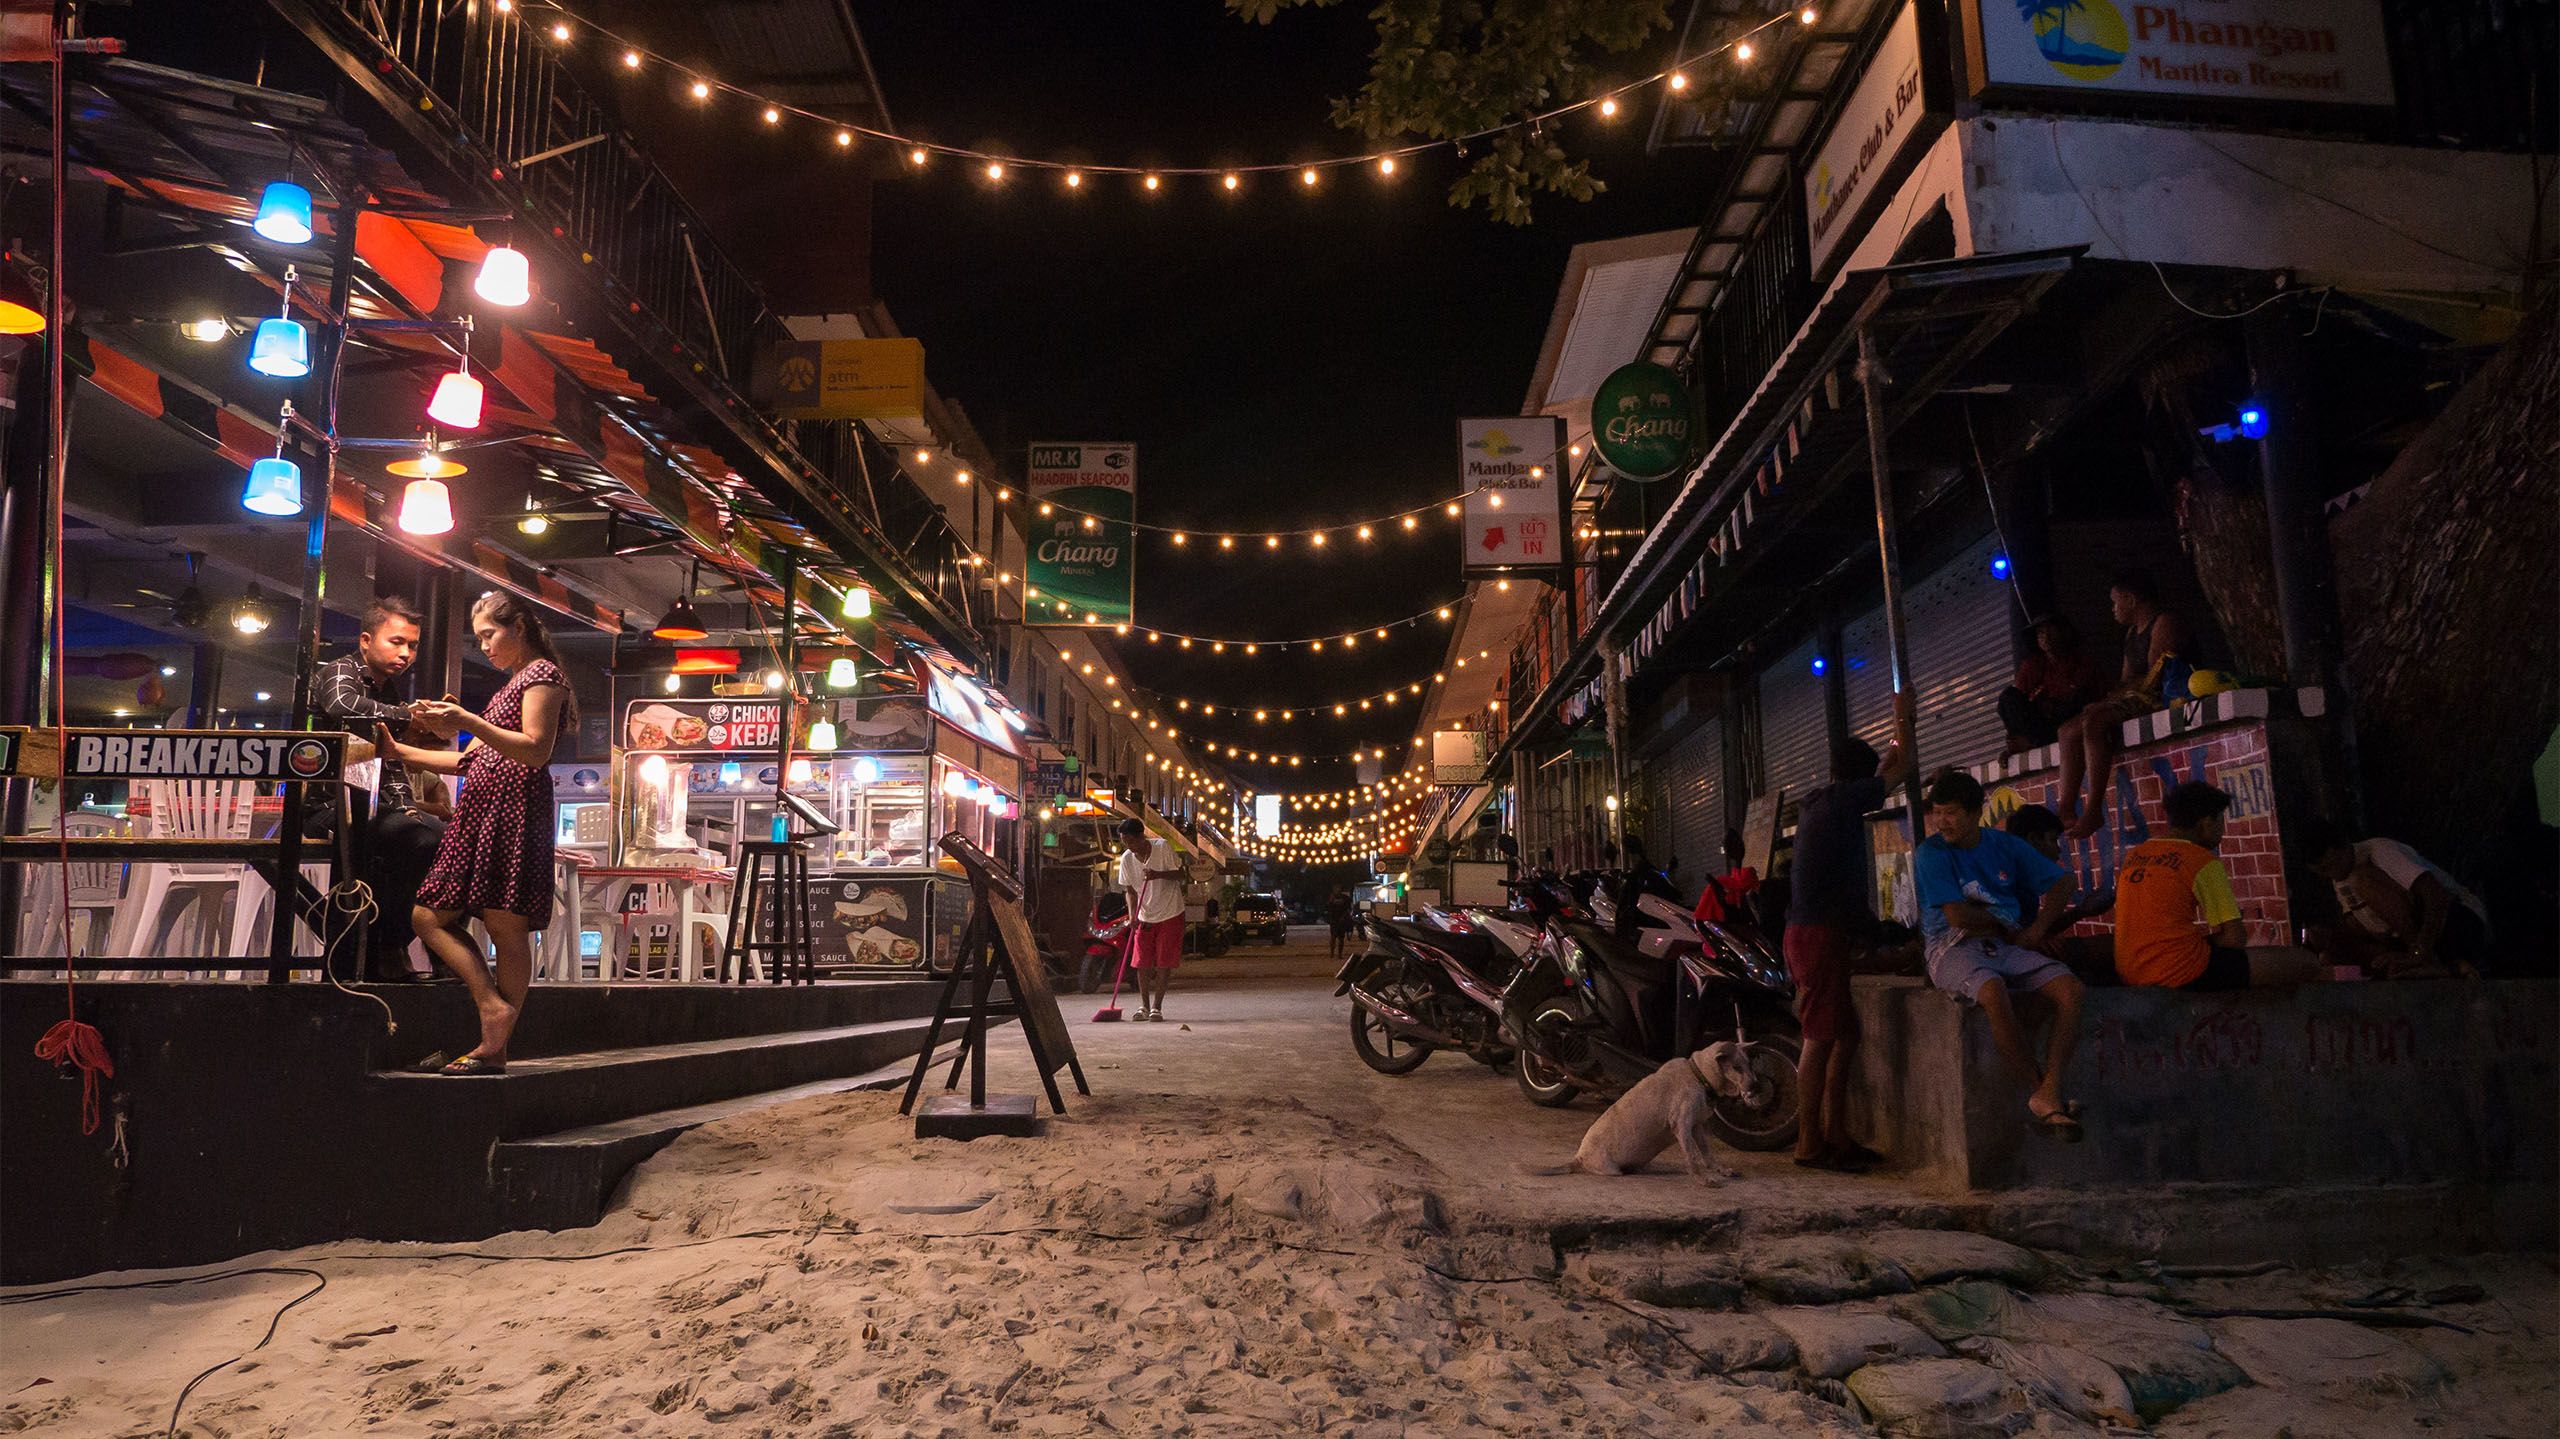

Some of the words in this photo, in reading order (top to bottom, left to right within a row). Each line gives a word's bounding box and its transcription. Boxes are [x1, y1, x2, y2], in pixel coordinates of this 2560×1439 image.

[2133, 4, 2336, 57] Phangan
[2138, 55, 2241, 85] Mantra
[2247, 62, 2345, 91] Resort
[1859, 122, 1883, 173] Club
[1885, 107, 1894, 137] &
[1896, 69, 1918, 119] Bar
[1605, 416, 1689, 443] Chang
[1034, 450, 1078, 466] MR.K
[1031, 473, 1078, 486] HAADRIN
[1080, 472, 1129, 486] SEAFOOD
[1519, 479, 1543, 490] Bar
[1037, 538, 1119, 568] Chang
[1523, 539, 1543, 555] IN
[732, 705, 780, 723] CHICK
[730, 723, 780, 746] KEBA
[76, 735, 288, 776] BREAKFAST
[2223, 768, 2270, 820] BAR
[809, 887, 830, 895] AUCE
[799, 920, 824, 928] SUCE
[820, 954, 848, 962] SAUCE
